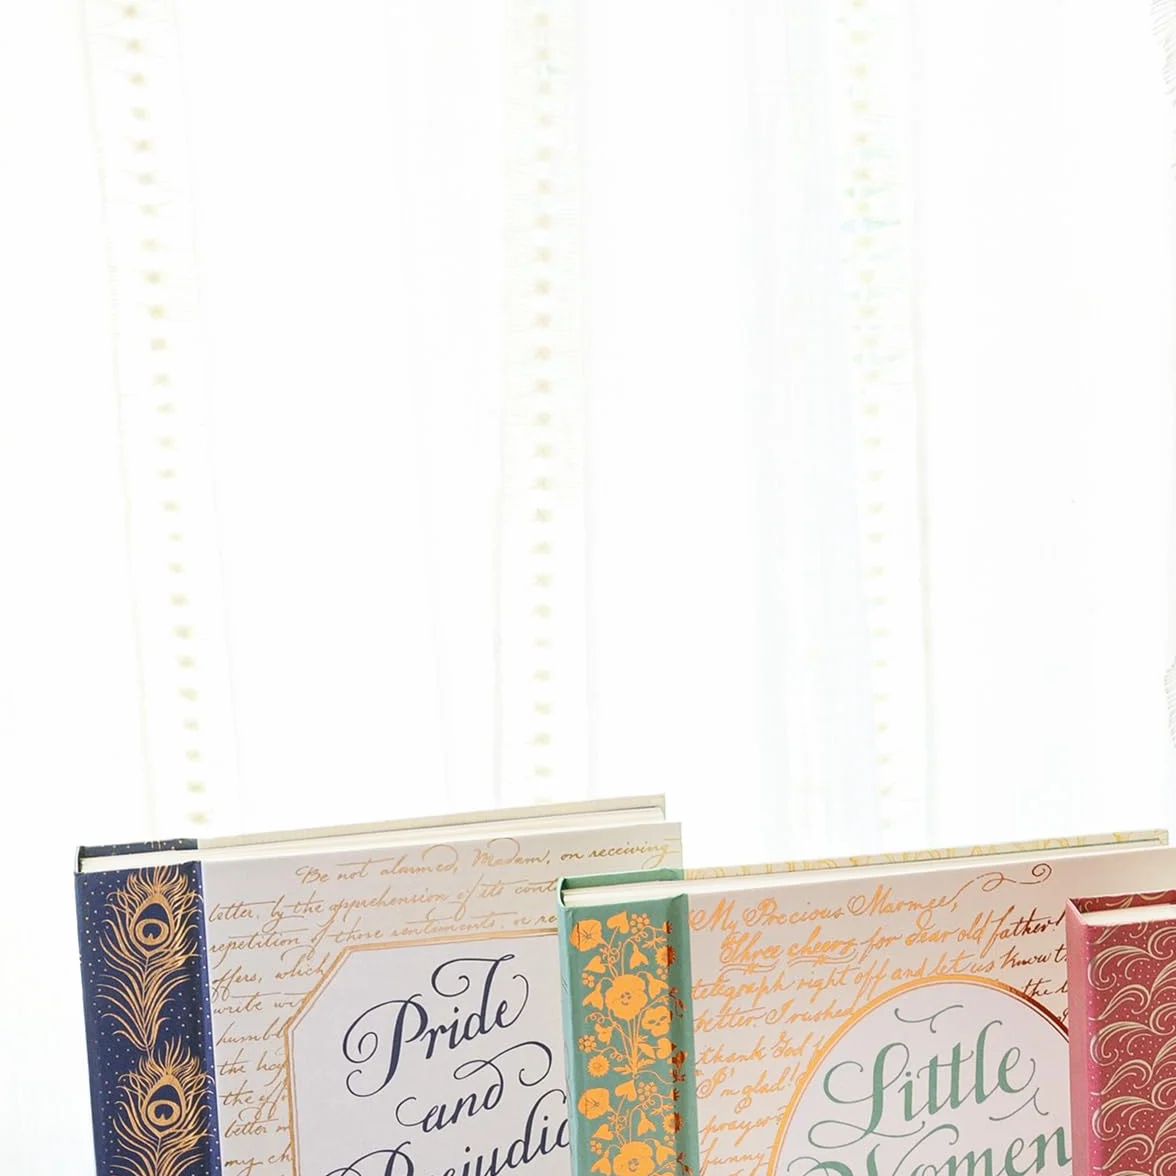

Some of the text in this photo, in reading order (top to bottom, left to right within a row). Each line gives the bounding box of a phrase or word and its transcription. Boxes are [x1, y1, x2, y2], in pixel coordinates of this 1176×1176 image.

[336, 857, 395, 881] not
[471, 837, 552, 868] Madam,
[560, 852, 585, 862] on
[588, 837, 682, 870] receiving
[742, 897, 844, 927] Precious
[342, 954, 530, 1098] Pride
[395, 1041, 552, 1132] and
[808, 1020, 1036, 1150] Little
